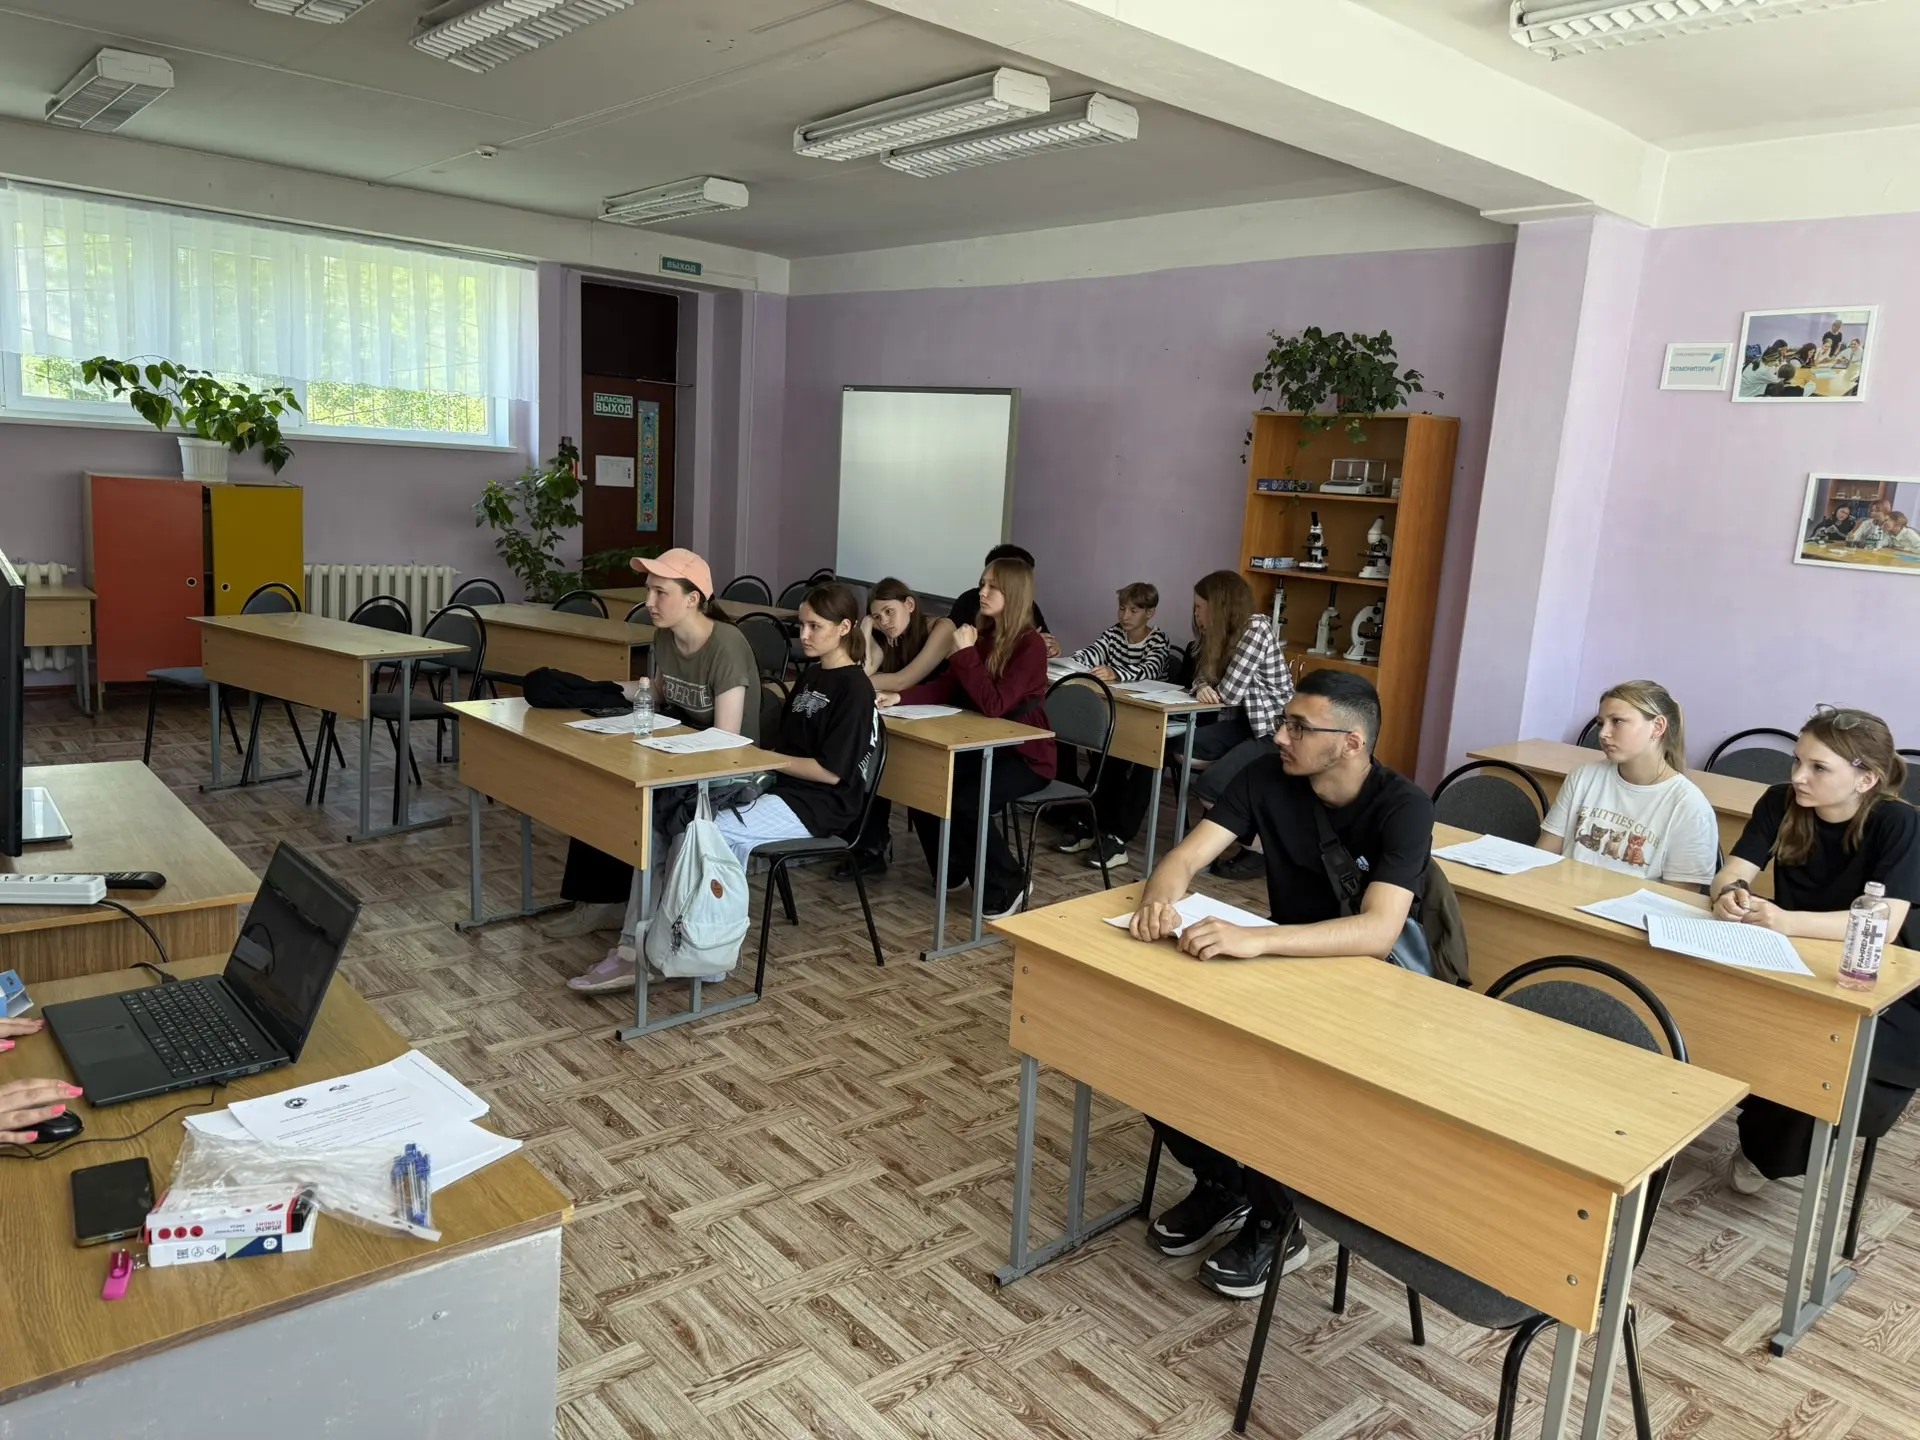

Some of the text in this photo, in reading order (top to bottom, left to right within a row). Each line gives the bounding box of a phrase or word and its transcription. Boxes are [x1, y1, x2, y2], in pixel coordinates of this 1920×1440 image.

[666, 260, 696, 273] ВЫХОД
[596, 395, 631, 405] ЗАПАСНЫЙ
[596, 402, 631, 416] ВЫХОД
[664, 681, 713, 708] BERTÉ
[1589, 807, 1635, 828] KITTIES
[1634, 823, 1660, 849] CLUB
[1864, 946, 1874, 969] VITAMIN
